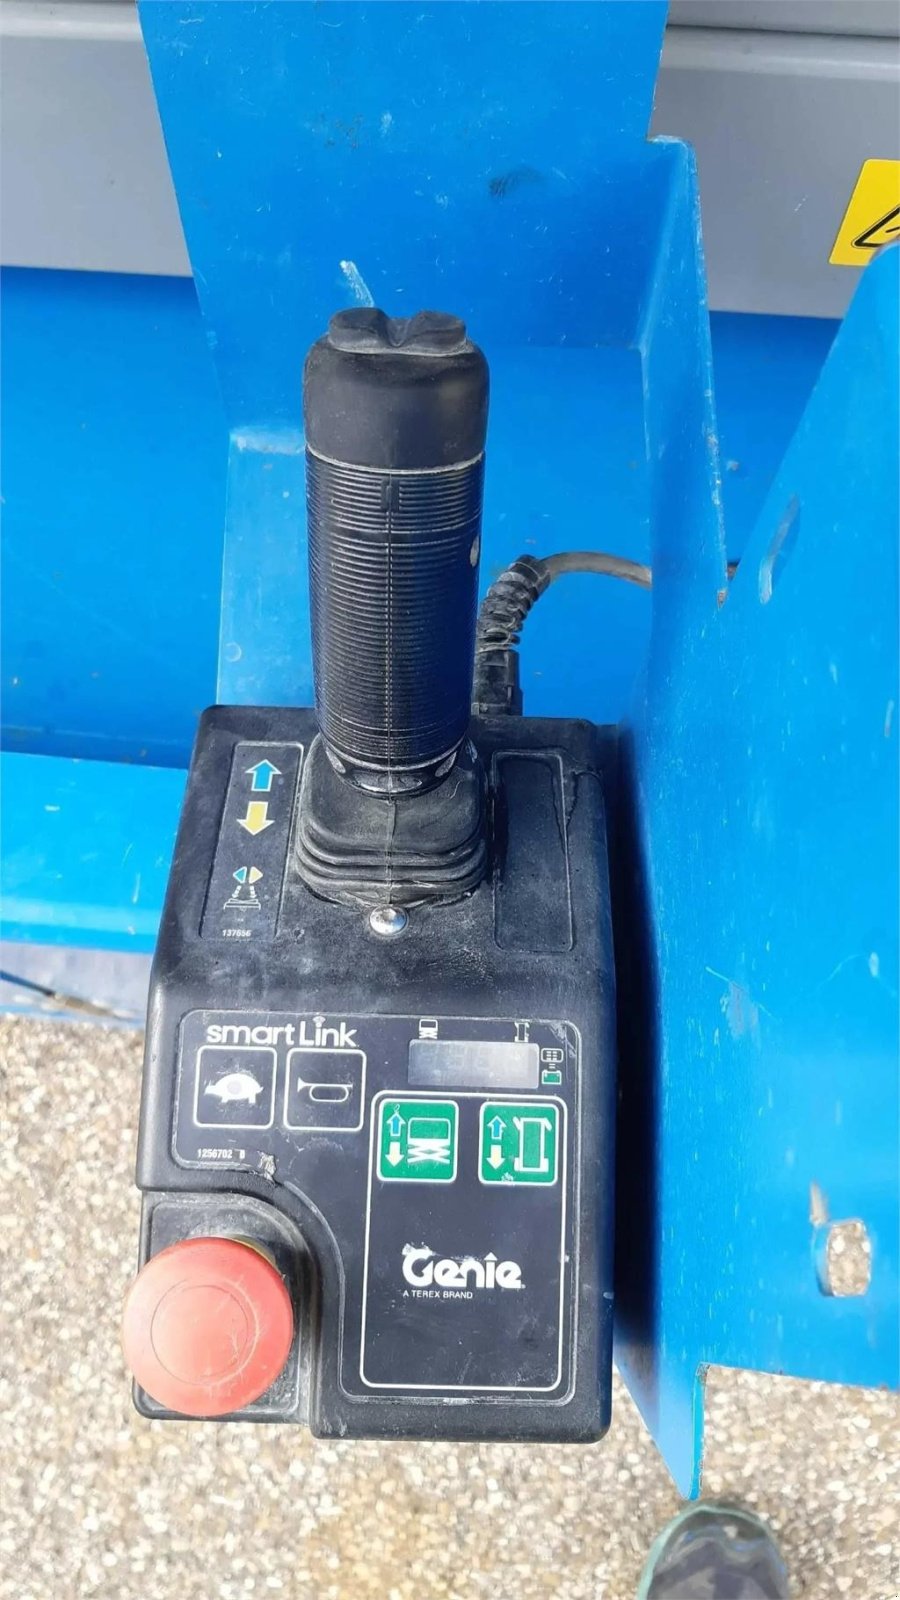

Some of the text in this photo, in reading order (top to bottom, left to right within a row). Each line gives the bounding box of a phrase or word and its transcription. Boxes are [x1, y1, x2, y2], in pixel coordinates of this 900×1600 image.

[197, 1148, 233, 1160] 1256702
[402, 1248, 523, 1289] Genie
[402, 1289, 473, 1300] A TEREX BRAND
